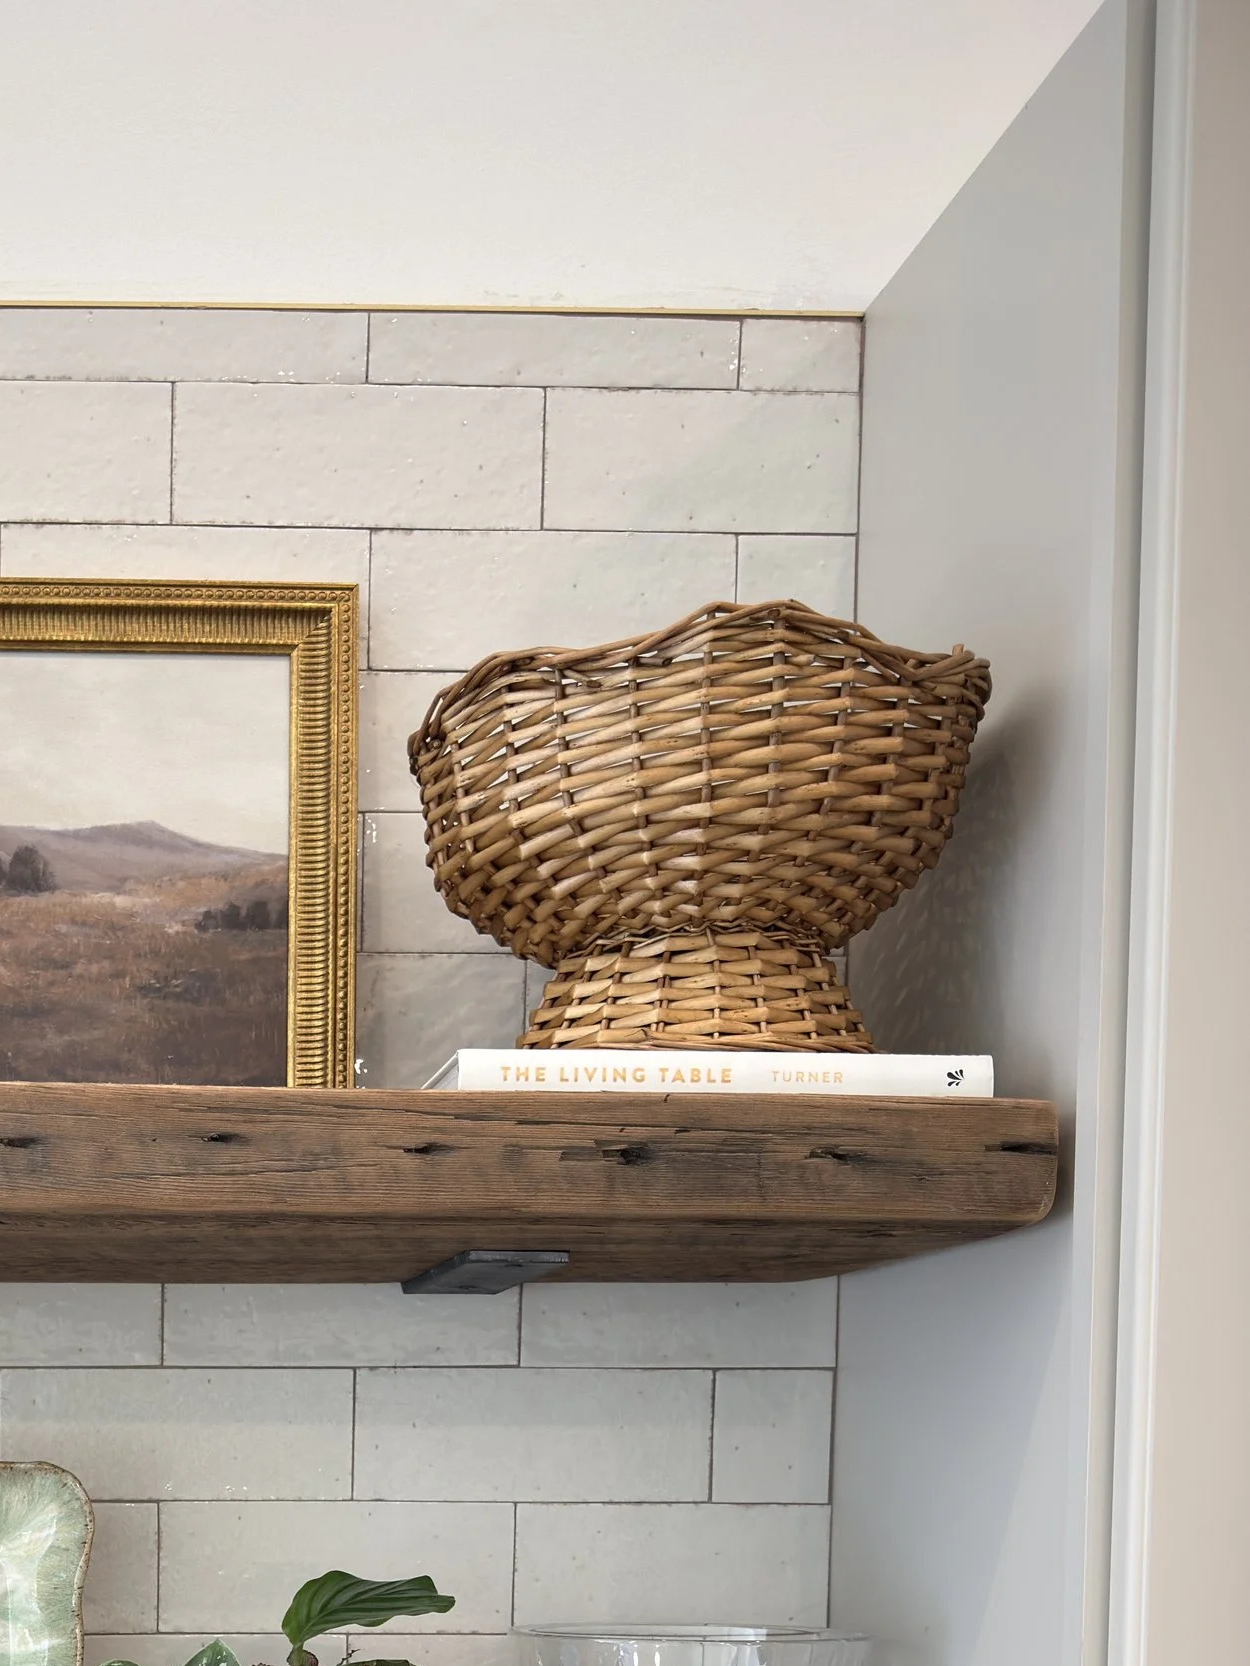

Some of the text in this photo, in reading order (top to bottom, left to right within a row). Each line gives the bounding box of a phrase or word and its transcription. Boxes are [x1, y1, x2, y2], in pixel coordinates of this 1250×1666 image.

[501, 1066, 844, 1084] THE LIVING TABLE TURNER
